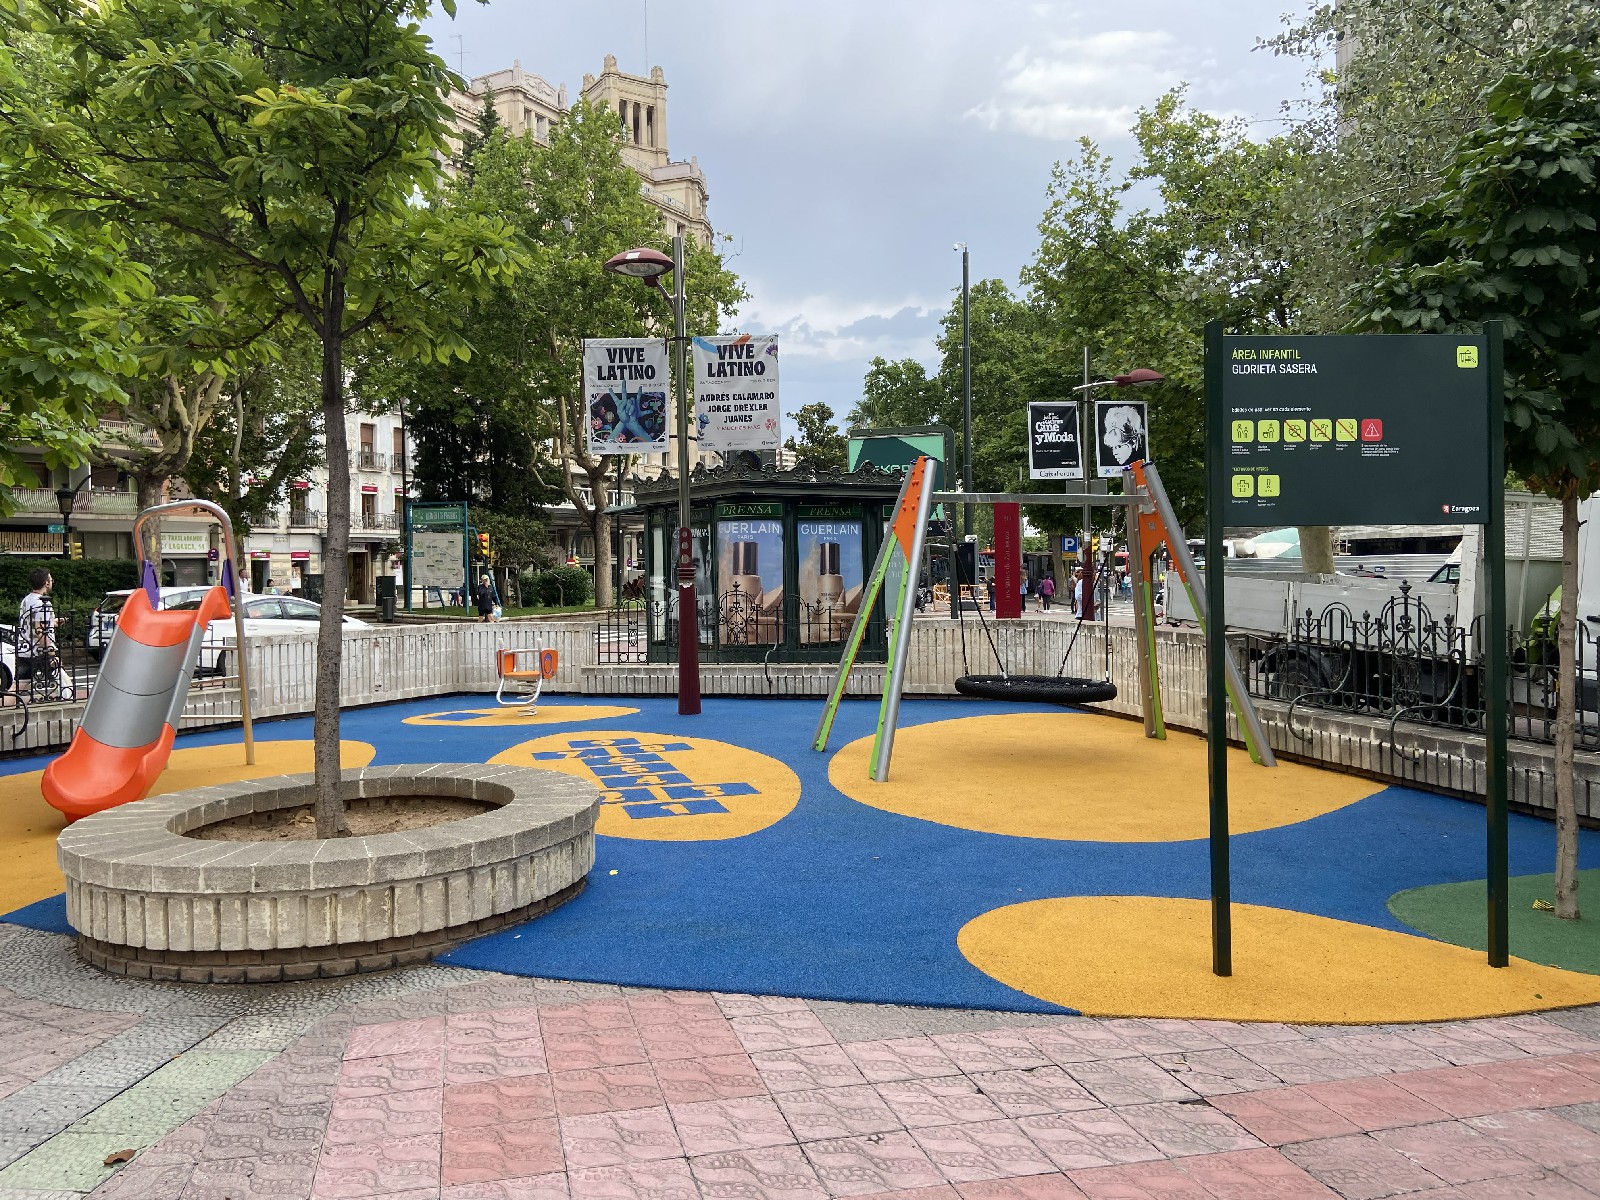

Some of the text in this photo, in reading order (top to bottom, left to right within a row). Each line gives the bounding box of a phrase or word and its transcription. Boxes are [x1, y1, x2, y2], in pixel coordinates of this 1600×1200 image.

[606, 347, 645, 363] VIVE
[717, 343, 754, 360] VIVE
[1232, 347, 1301, 360] ÁREA INFANTIL
[597, 364, 655, 380] LATINO
[707, 360, 766, 378] LATINO
[1232, 363, 1318, 374] GLORIETA SASERA
[700, 392, 775, 402] ANDRÉS CALAMARO
[733, 404, 768, 412] DREXLER
[723, 415, 753, 423] JUANES
[1035, 421, 1060, 433] Cine
[723, 505, 772, 514] PRENSA
[809, 507, 852, 516] PRENSA
[1451, 505, 1480, 514] Zaragoza
[719, 522, 780, 534] GUERLAIN
[801, 524, 858, 535] GUERLAIN
[1064, 538, 1075, 551] P
[660, 803, 690, 815] 1
